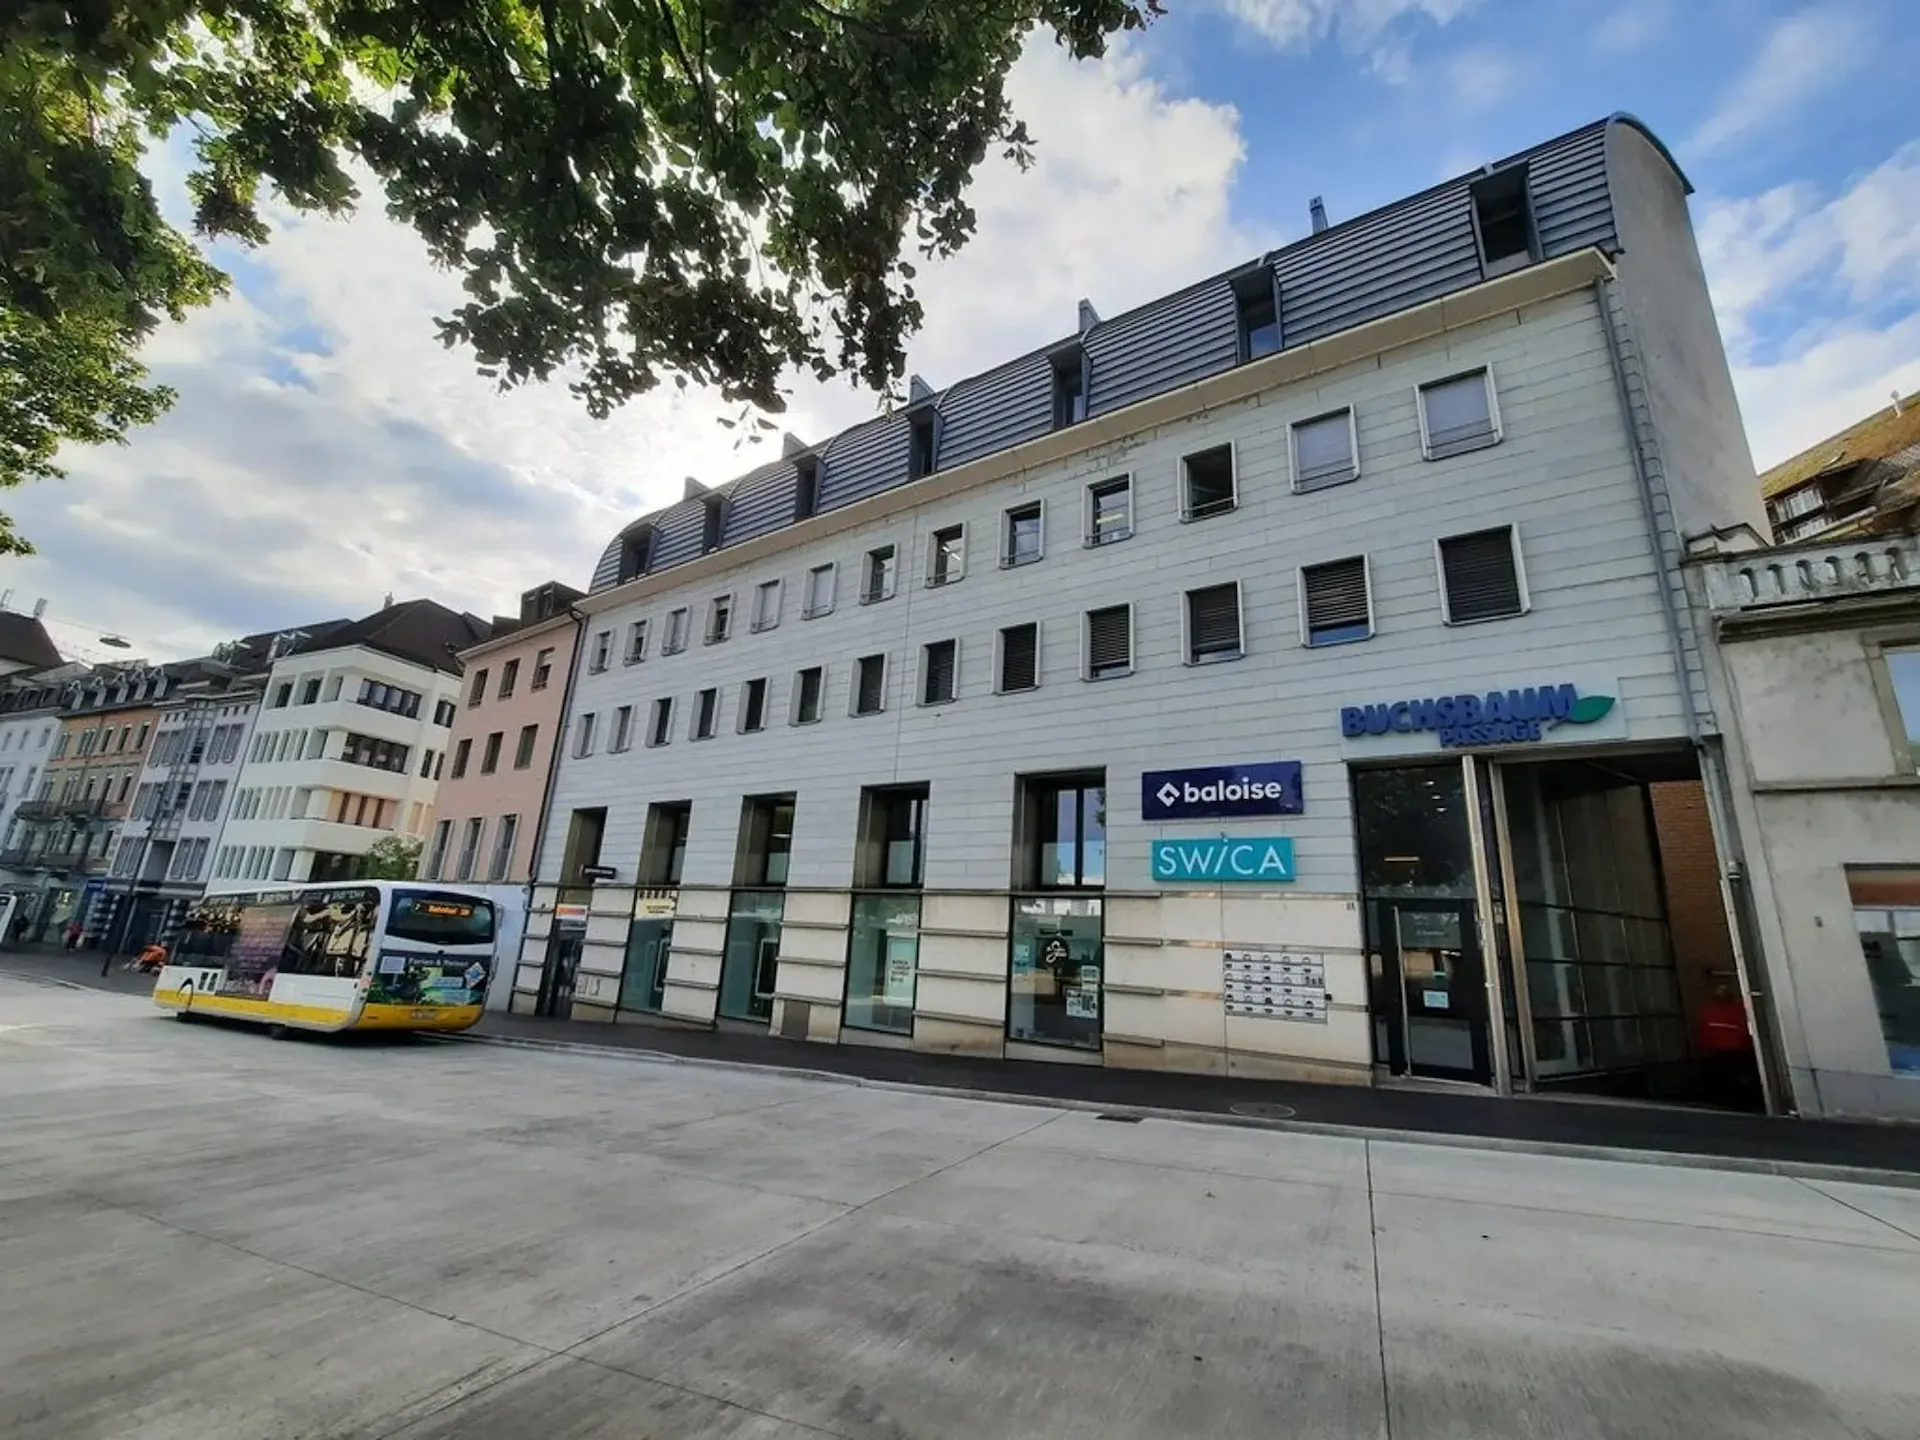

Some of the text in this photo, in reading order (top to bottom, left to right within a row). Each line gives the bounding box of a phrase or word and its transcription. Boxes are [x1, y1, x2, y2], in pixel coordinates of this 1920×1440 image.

[1341, 683, 1578, 737] BUCHSBAUM
[1440, 721, 1542, 748] PASSAGE
[1184, 776, 1282, 803] baloise
